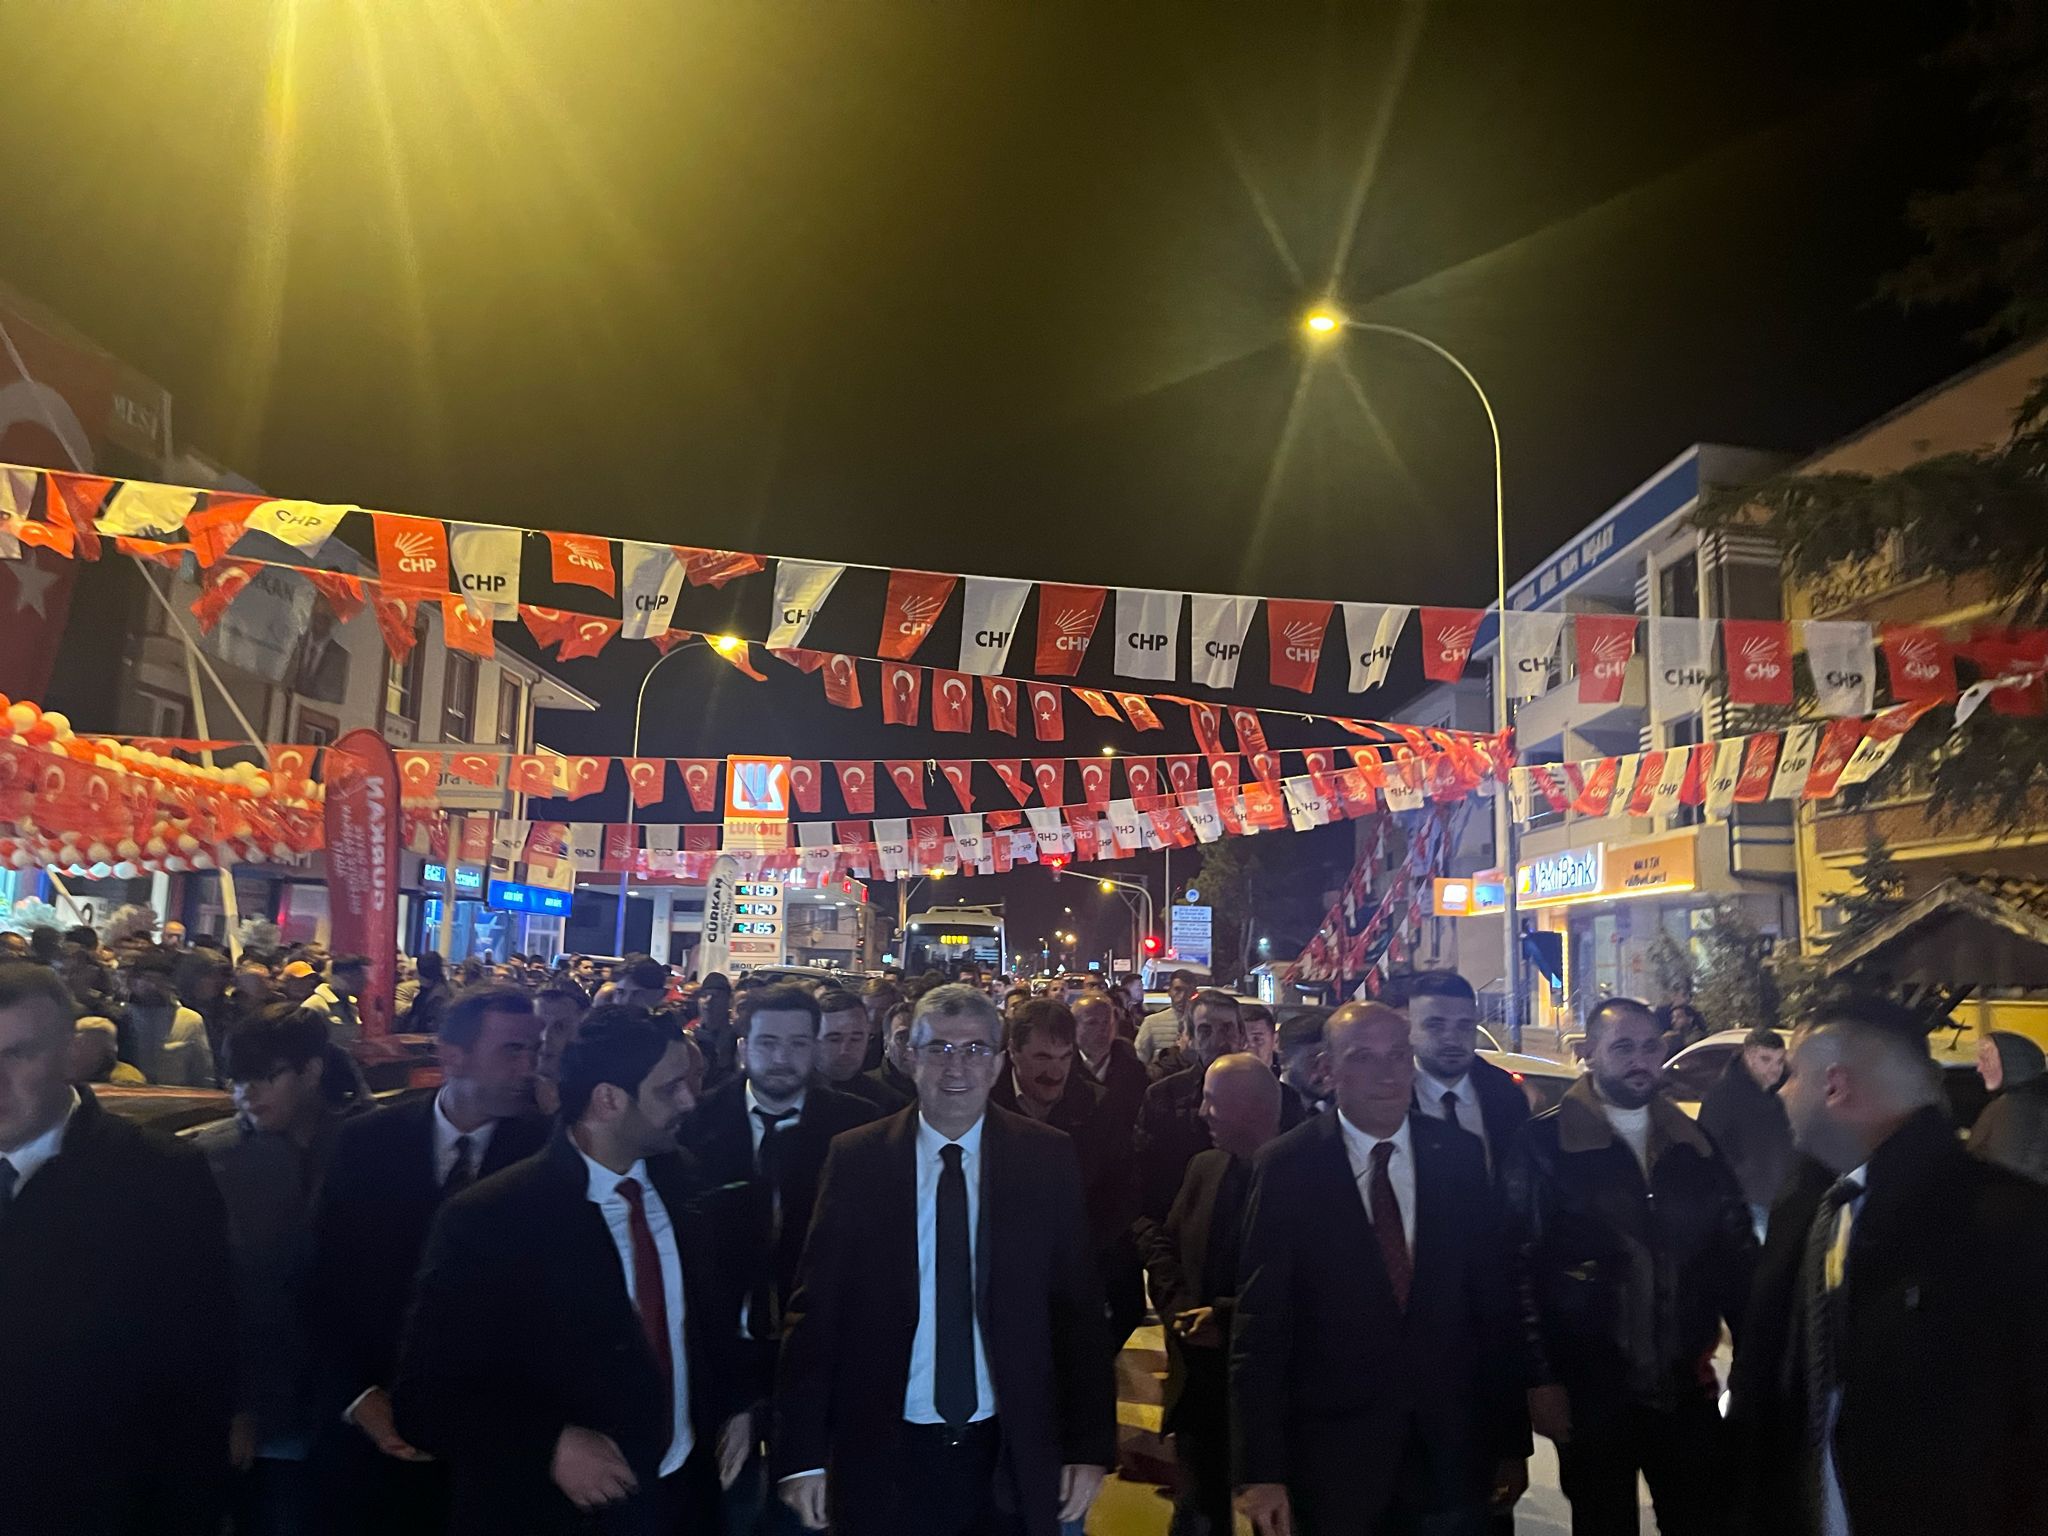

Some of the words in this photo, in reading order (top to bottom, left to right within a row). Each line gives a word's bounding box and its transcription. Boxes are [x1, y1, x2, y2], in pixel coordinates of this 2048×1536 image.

[275, 508, 322, 528] CHP
[398, 556, 437, 574] CHP
[567, 553, 604, 572] CHP
[462, 573, 506, 593] CHP
[635, 594, 669, 612] CHP
[1128, 632, 1168, 652] CHP
[1205, 641, 1240, 661] CHP
[1286, 646, 1320, 663] CHP
[1745, 665, 1781, 680] CHP
[1826, 671, 1863, 687] CHP
[1904, 663, 1941, 679] CHP
[1782, 758, 1807, 774] CHP
[1590, 787, 1609, 799] CHP
[1658, 784, 1678, 796] CHP
[729, 821, 782, 836] LUKOIL
[1536, 851, 1597, 892] VakıfBank
[706, 877, 723, 943] GÜRKAN
